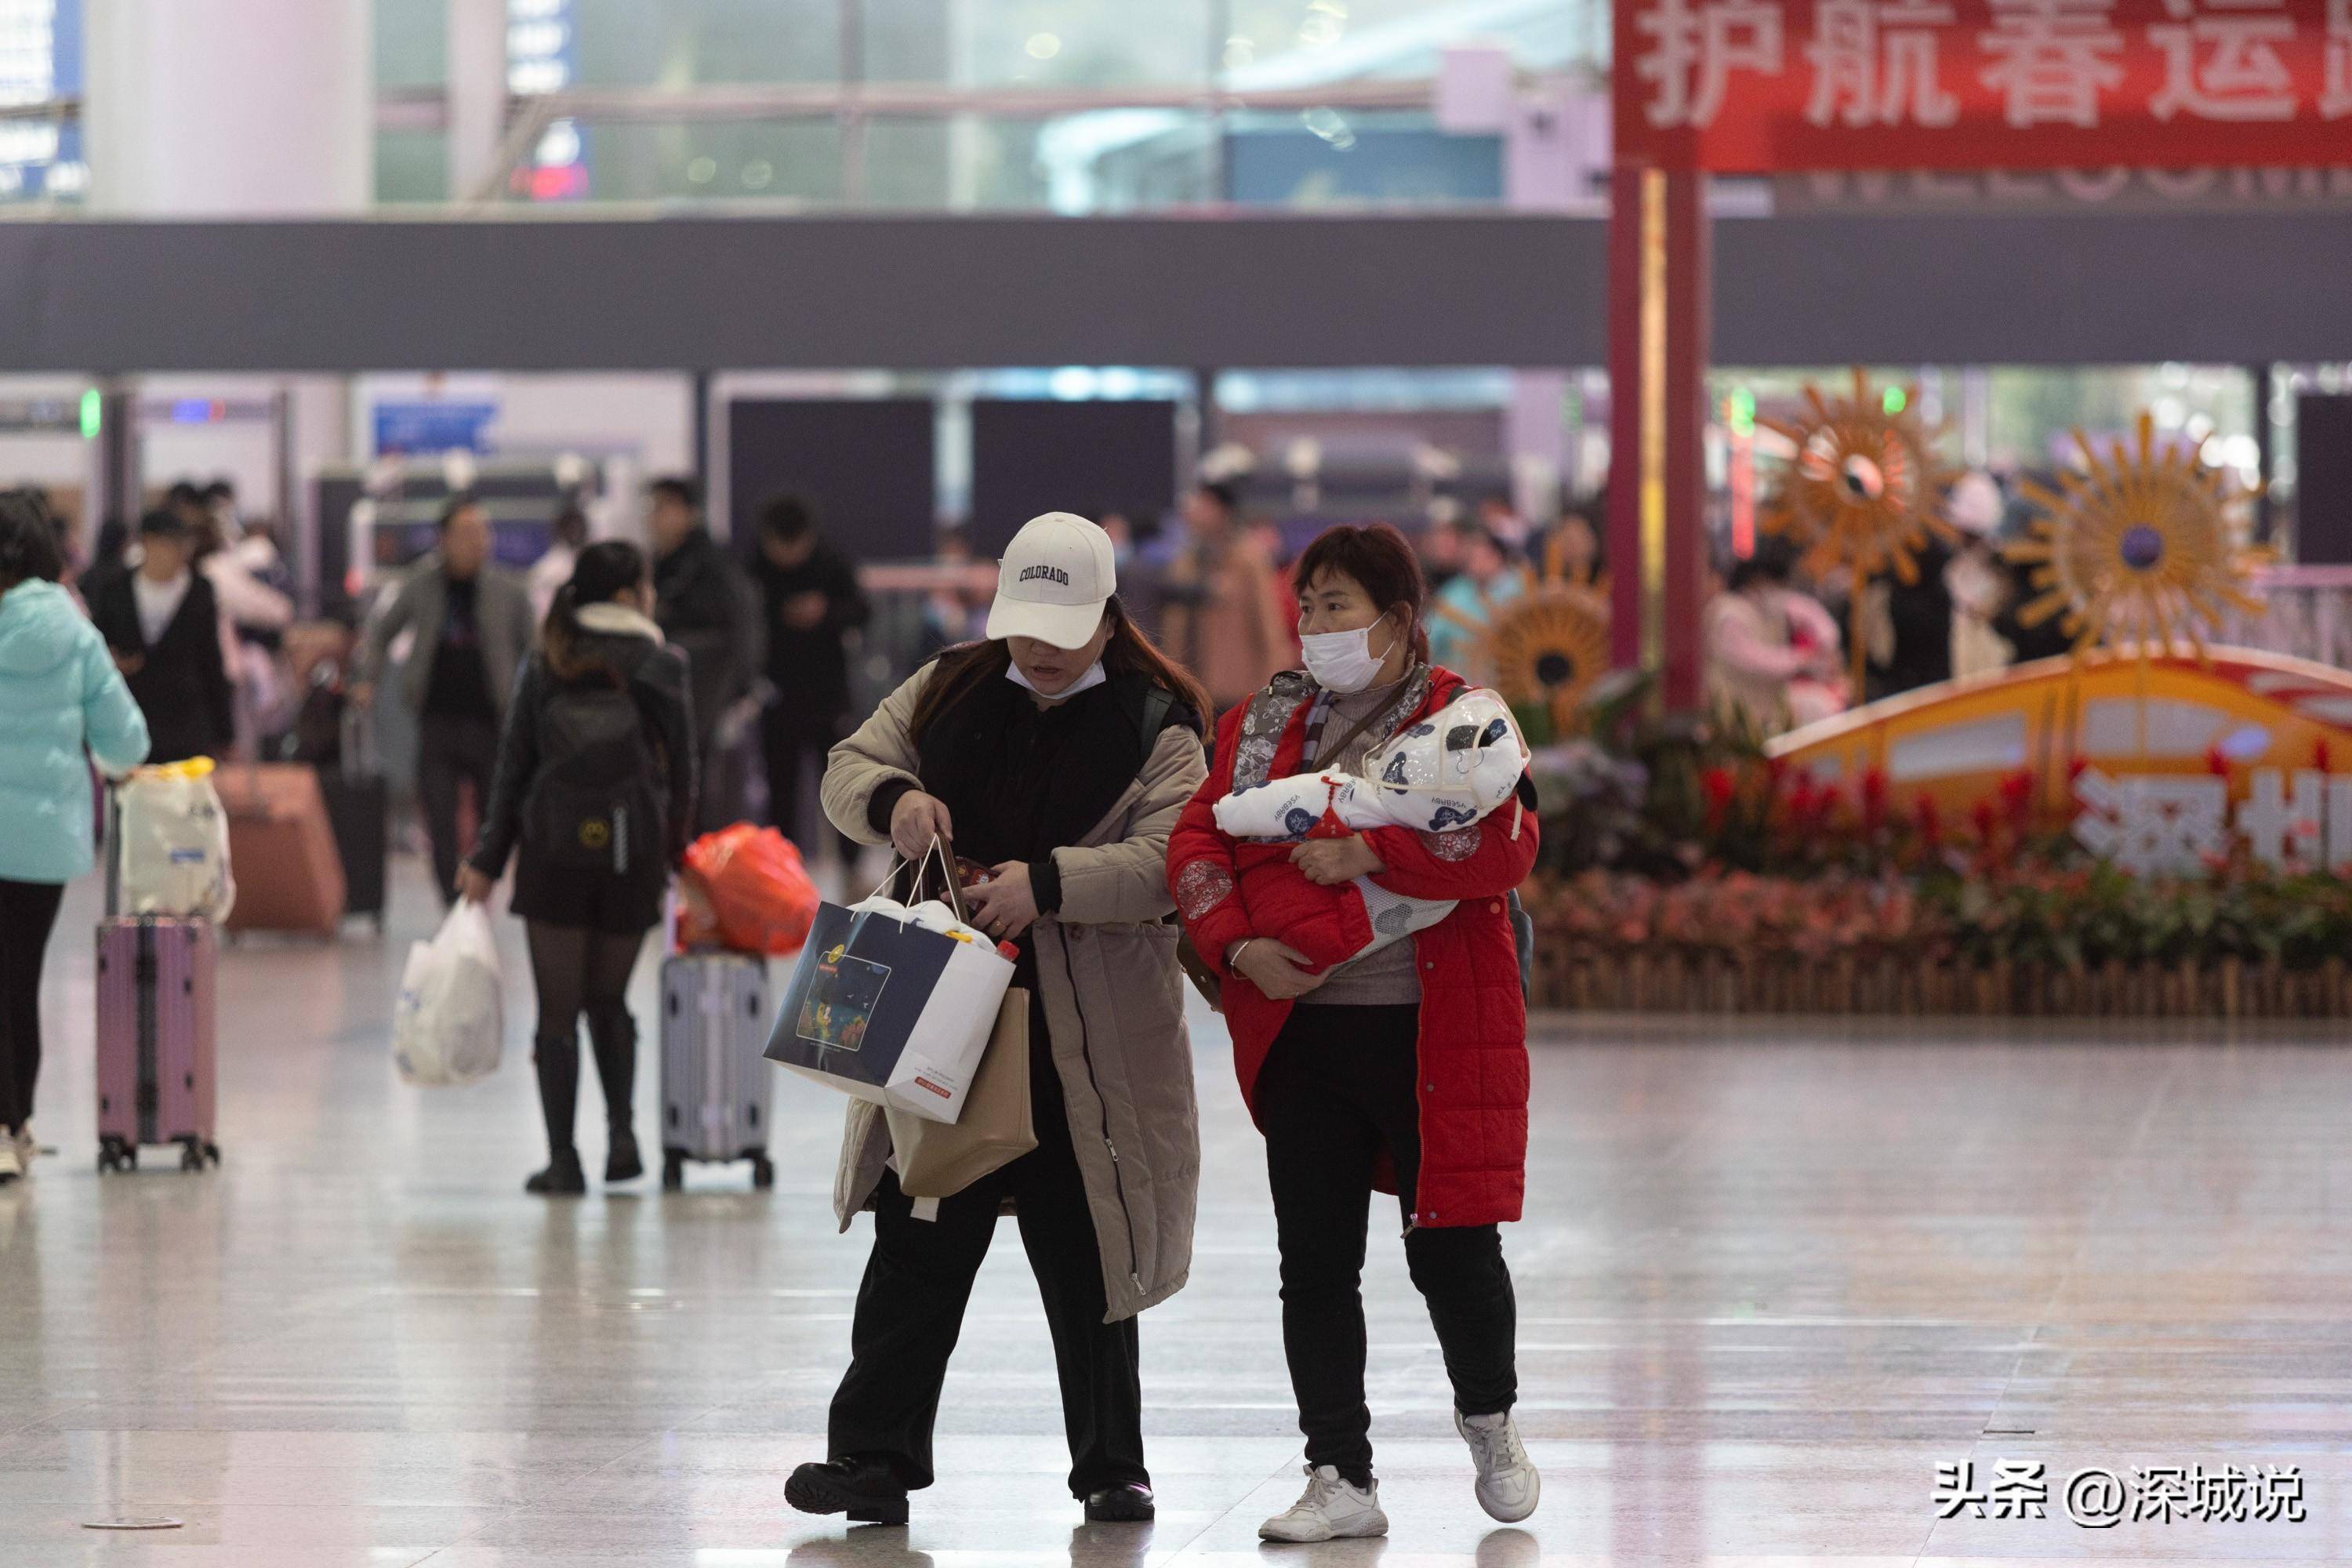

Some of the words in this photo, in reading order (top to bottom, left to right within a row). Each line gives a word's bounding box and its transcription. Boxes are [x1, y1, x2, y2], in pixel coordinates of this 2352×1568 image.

[1636, 0, 2352, 128] 护航春运
[1019, 565, 1069, 586] COLORADO
